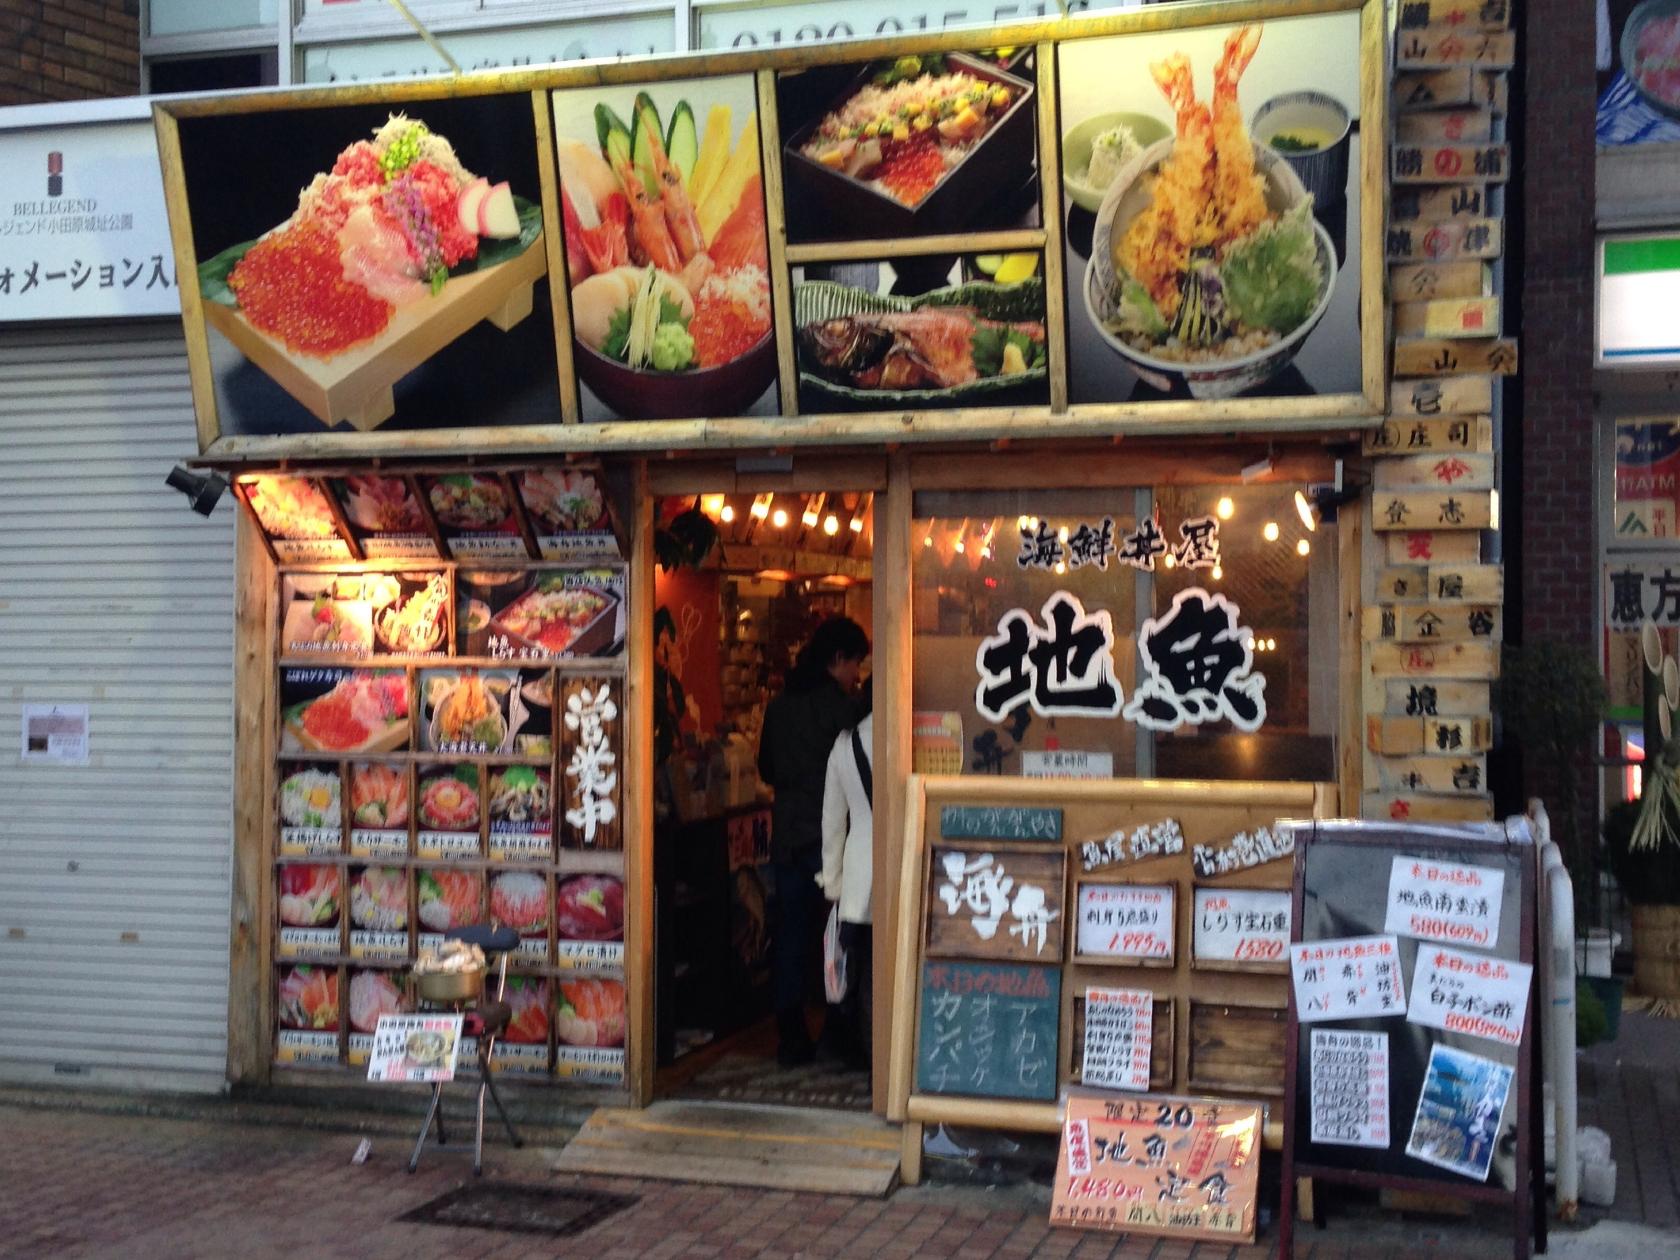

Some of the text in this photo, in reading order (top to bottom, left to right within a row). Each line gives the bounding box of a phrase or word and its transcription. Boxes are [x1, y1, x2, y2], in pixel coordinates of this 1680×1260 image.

[0, 213, 134, 236] ジェンド小田原城址公園
[13, 200, 97, 216] BELLEGEND
[0, 255, 178, 295] ォメーション入
[1017, 515, 1222, 571] 海鮮丼屋
[976, 588, 1266, 731] 地魚
[565, 683, 618, 845] 営業中
